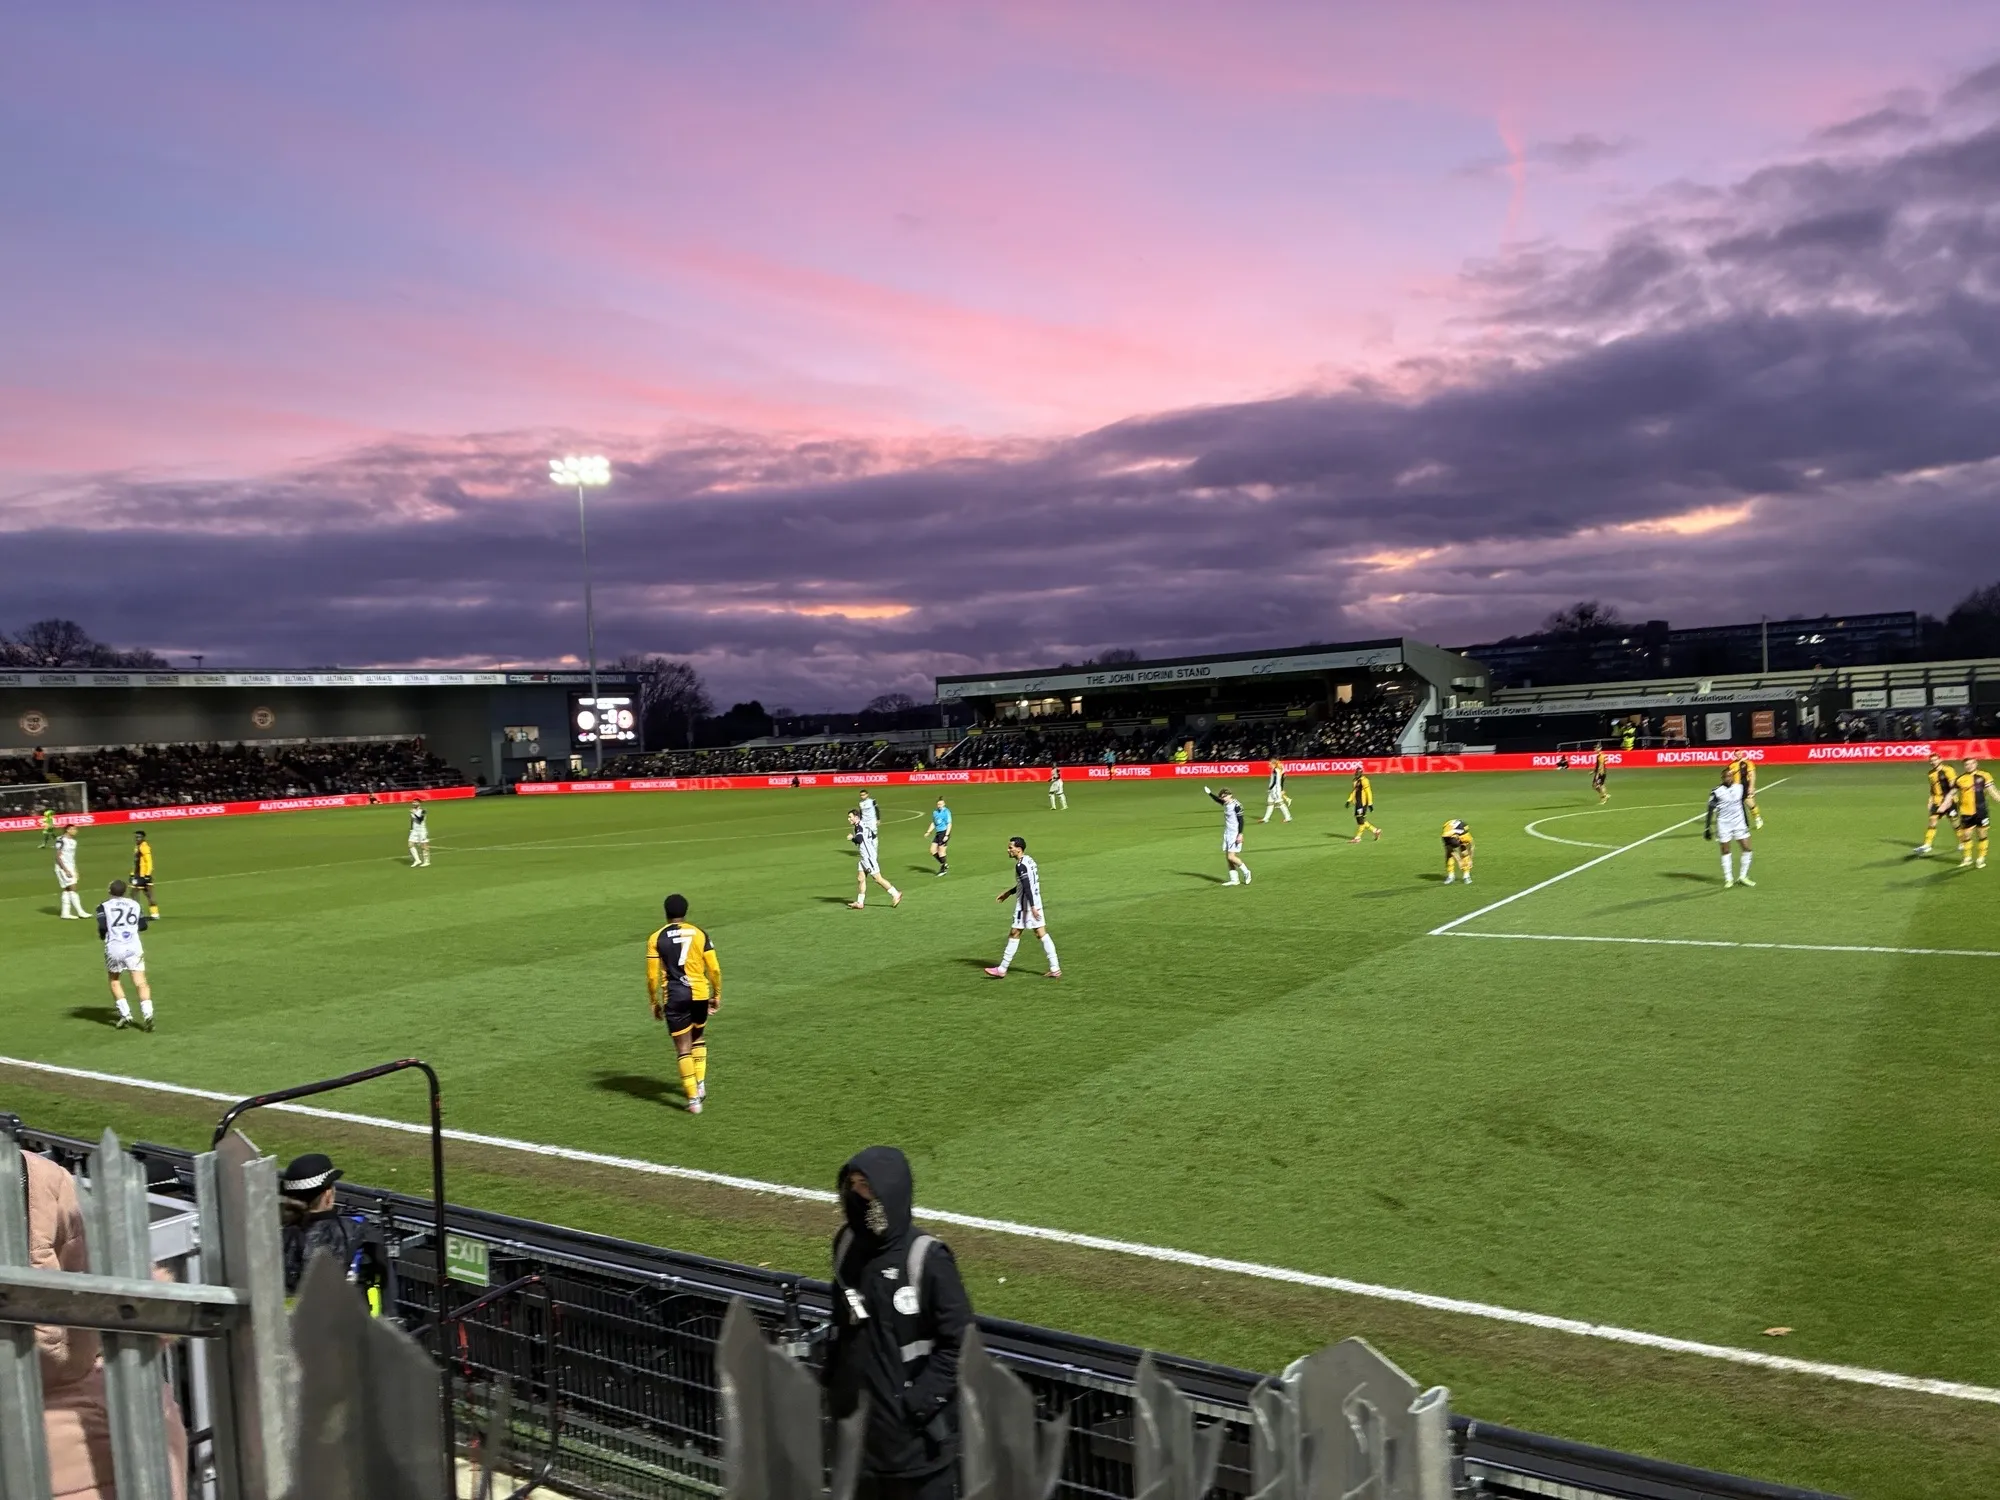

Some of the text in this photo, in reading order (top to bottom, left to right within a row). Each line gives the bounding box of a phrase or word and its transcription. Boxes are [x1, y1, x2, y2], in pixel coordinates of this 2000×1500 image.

[1086, 675, 1105, 685] THE
[1108, 673, 1134, 684] JOHN
[1176, 667, 1211, 678] STAND
[1502, 706, 1532, 715] Power
[1657, 751, 1721, 763] INDUSTRIAL
[1808, 744, 1932, 759] AUTOMATIC DOORS
[1533, 753, 1622, 766] ROLLE SHUTERS
[1088, 768, 1110, 777] ROLLE
[1175, 764, 1250, 775] INDUSTRIAL DOORS
[908, 772, 969, 782] AUTOMATIC DOORS
[258, 799, 313, 811] AUTOMATIC
[313, 797, 345, 807] DOORS
[129, 805, 226, 820] INDUSTRIAL DOORS
[38, 815, 95, 827] SUTTERS
[110, 907, 137, 927] 26
[672, 936, 692, 966] 7
[448, 1236, 486, 1264] EXIT
